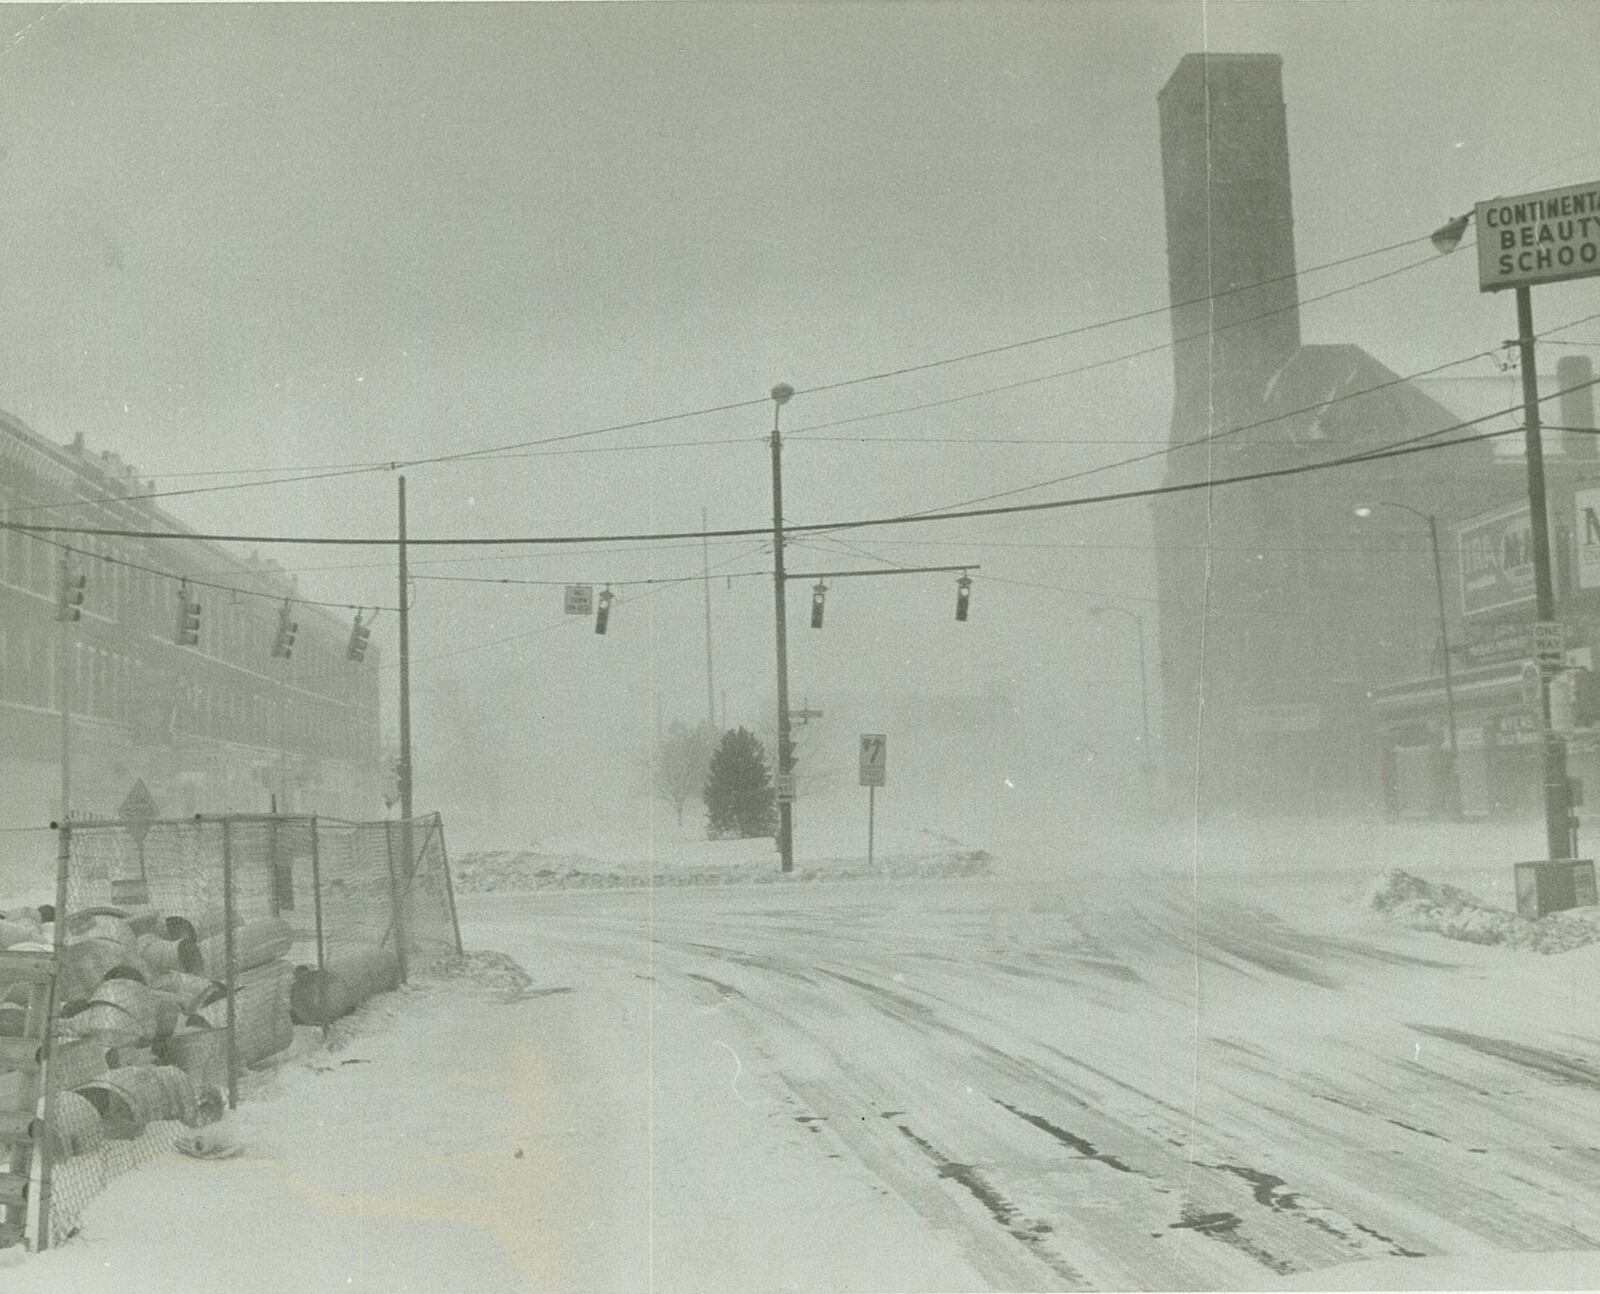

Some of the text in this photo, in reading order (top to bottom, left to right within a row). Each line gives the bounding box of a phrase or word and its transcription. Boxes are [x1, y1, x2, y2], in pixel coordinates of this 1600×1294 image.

[1486, 191, 1600, 228] CONTINENT
[1536, 625, 1560, 637] ONE
[1536, 639, 1560, 649] WAY
